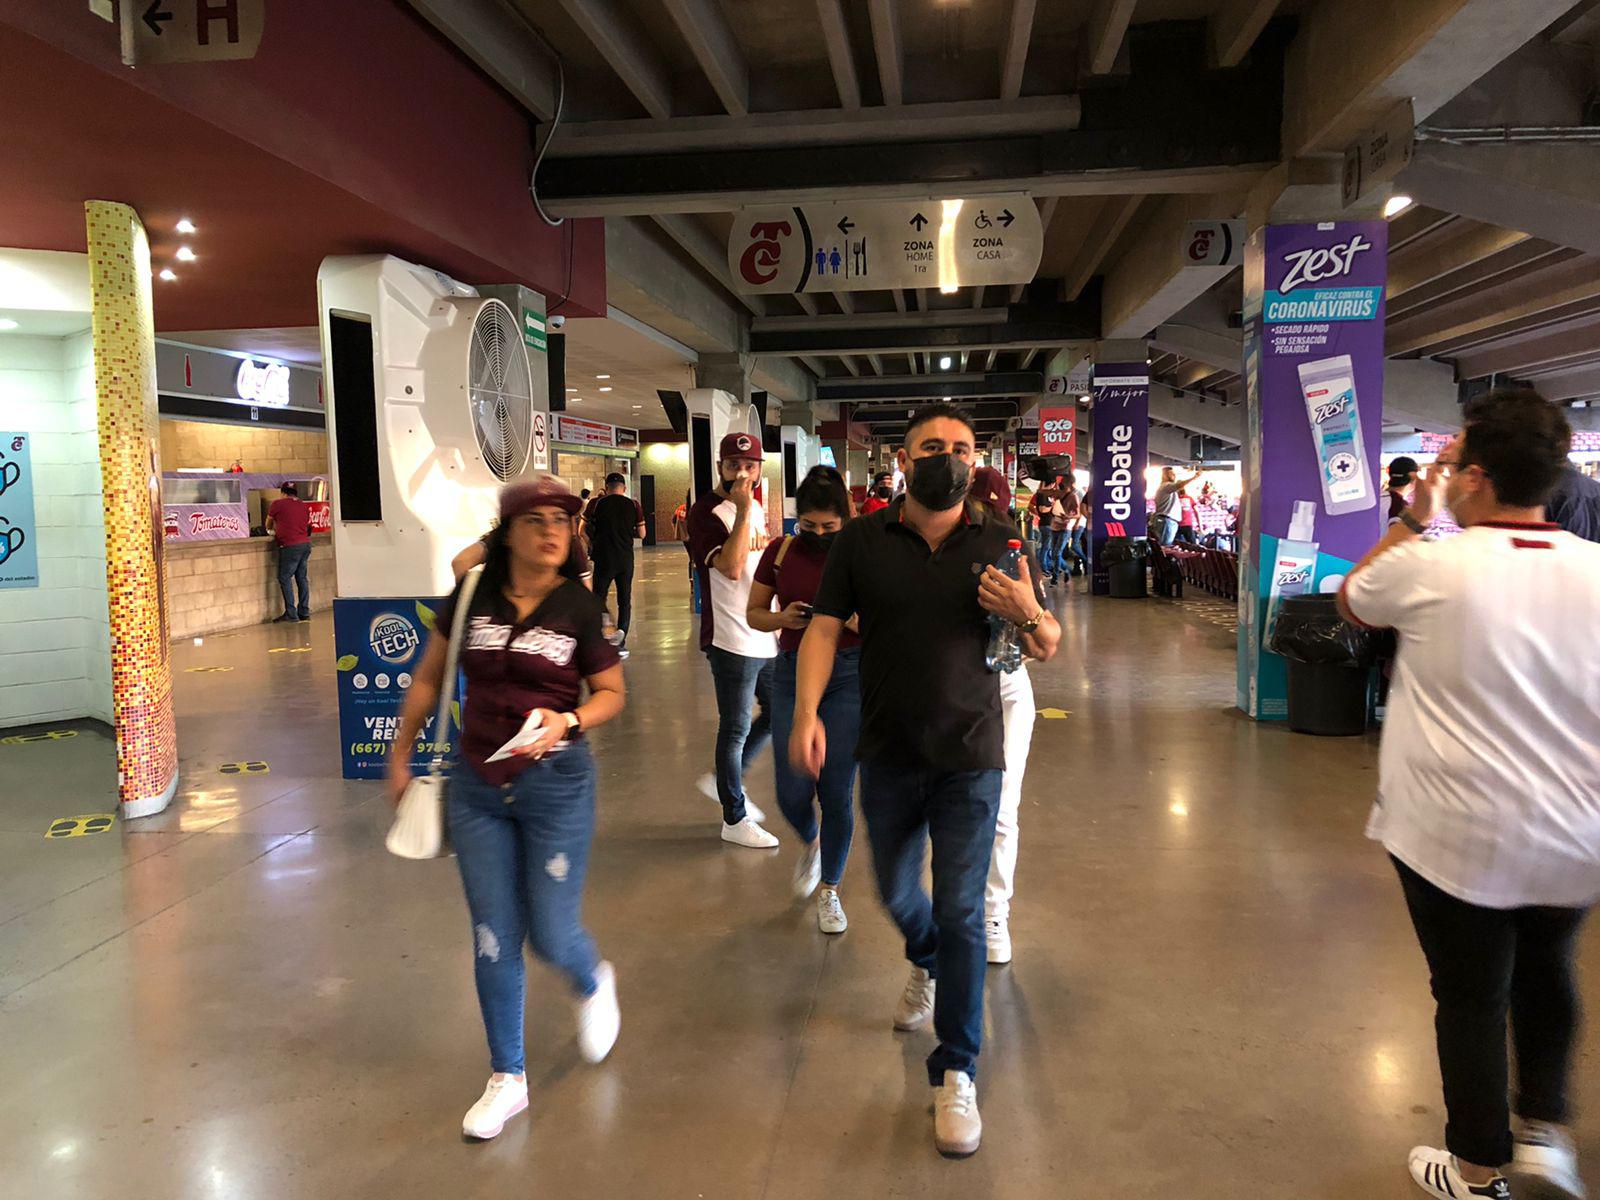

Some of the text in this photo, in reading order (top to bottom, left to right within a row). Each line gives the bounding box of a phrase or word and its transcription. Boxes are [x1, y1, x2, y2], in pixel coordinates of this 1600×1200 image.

[196, 0, 239, 45] H
[904, 240, 934, 251] ZONA
[972, 237, 1004, 248] ZONA
[906, 251, 934, 262] HOME
[976, 250, 1001, 261] CASA
[913, 264, 927, 274] 1ra
[1314, 291, 1338, 300] EFICAZ
[1338, 290, 1365, 299] CONTRA
[1268, 299, 1374, 319] CORONAVIRUS
[1274, 323, 1330, 334] SECADO RÁPIDO
[1274, 334, 1327, 346] SIN SENSACIÓN
[1274, 345, 1310, 353] PEGAJOSA
[1043, 431, 1072, 443] 101.7
[1104, 424, 1132, 521] debate
[189, 511, 239, 535] Tomateros
[376, 622, 402, 637] KOOL
[370, 629, 420, 658] TECH
[425, 716, 434, 728] Y
[373, 728, 426, 740] REA
[351, 743, 386, 756] (667)
